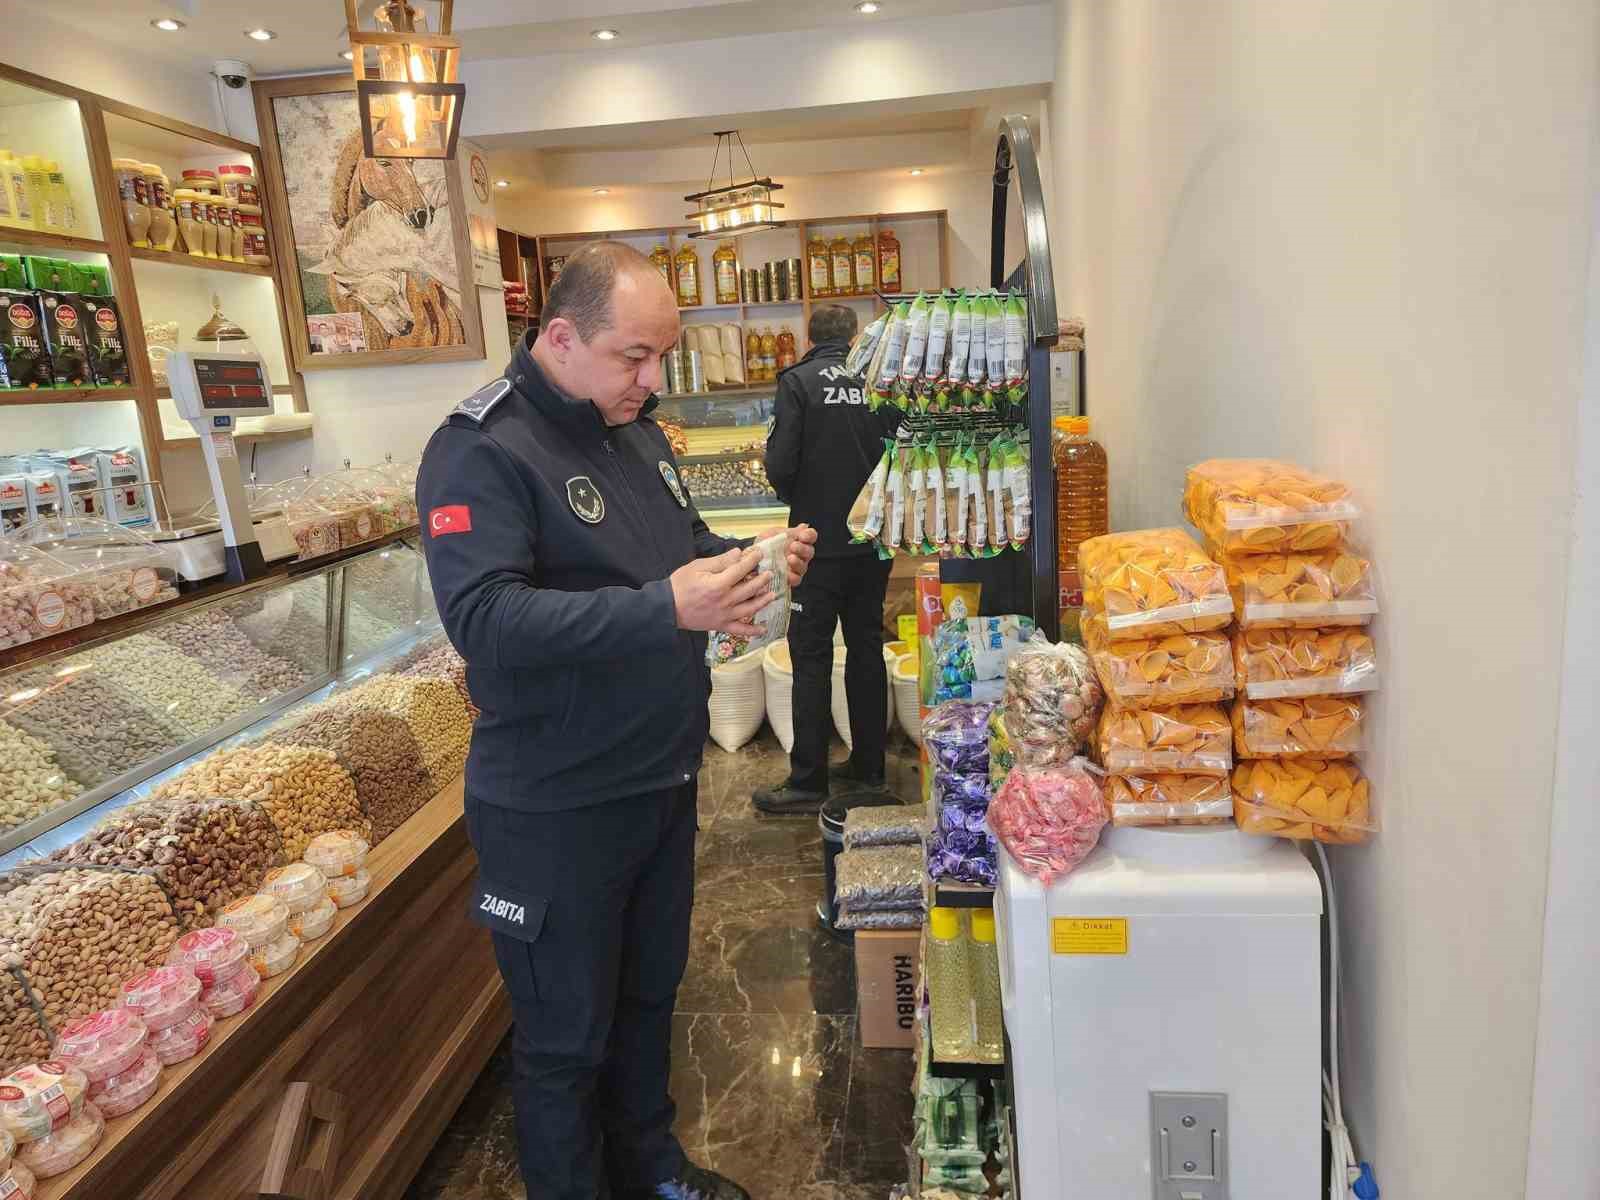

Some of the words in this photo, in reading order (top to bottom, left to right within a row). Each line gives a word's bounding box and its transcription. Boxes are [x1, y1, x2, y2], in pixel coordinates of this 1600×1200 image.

[12, 335, 39, 348] Filiz
[60, 334, 82, 347] Filiz
[101, 337, 122, 349] Filiz
[480, 894, 525, 924] ZABITA
